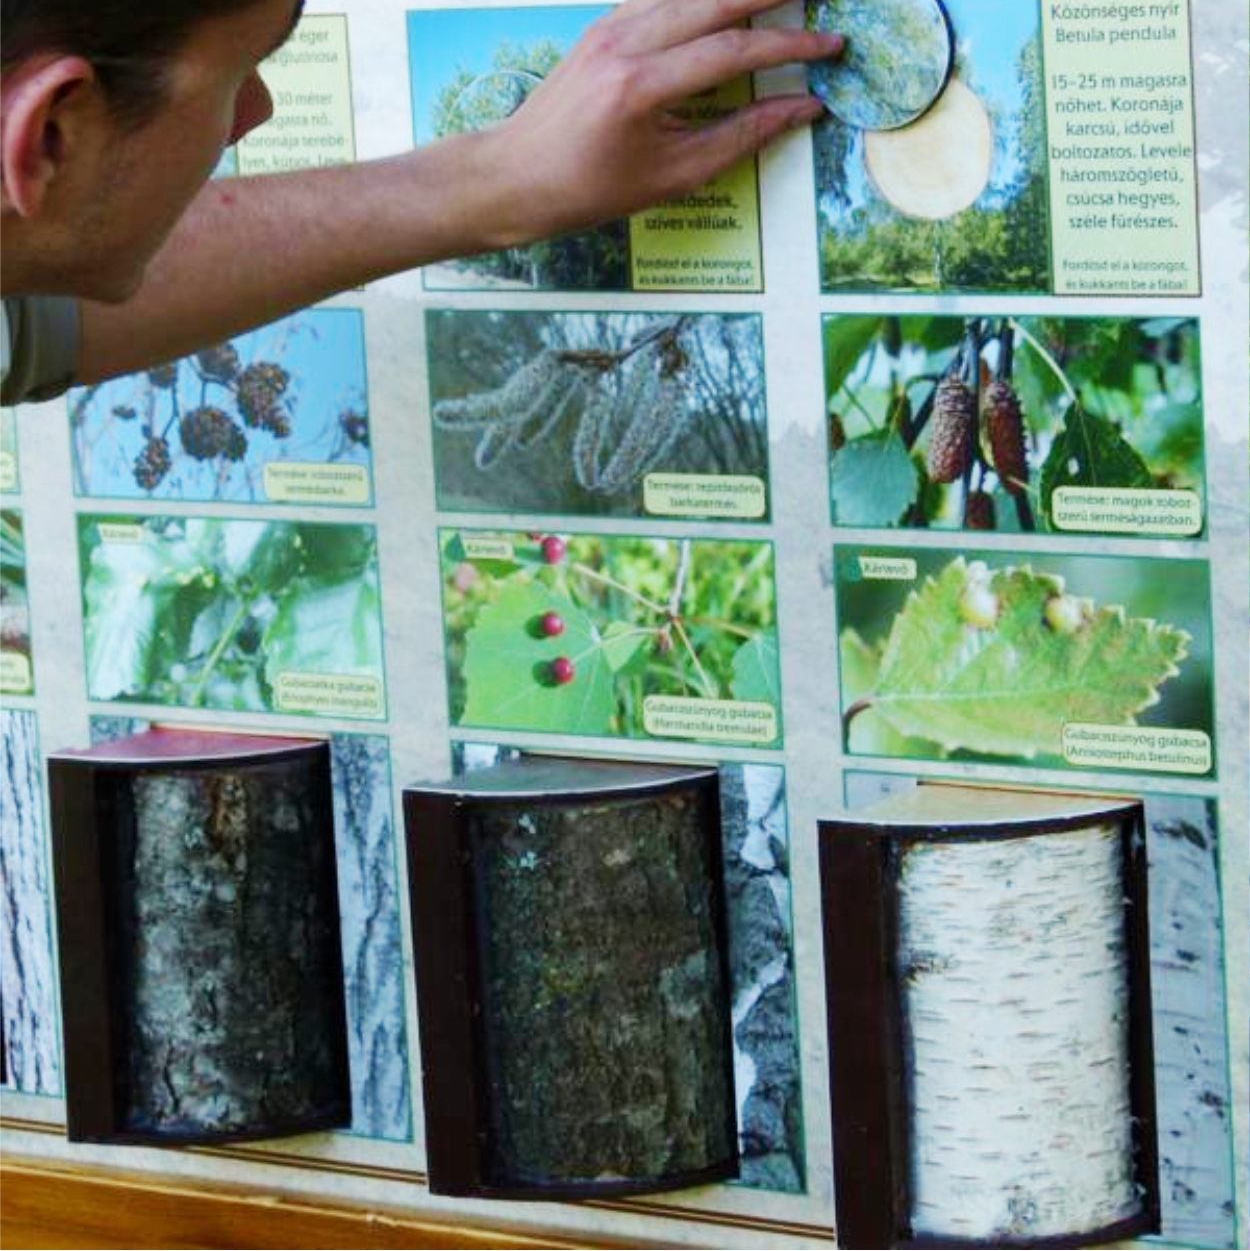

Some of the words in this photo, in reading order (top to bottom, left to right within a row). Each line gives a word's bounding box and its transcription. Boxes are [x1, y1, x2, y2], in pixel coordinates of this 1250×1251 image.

[1051, 1, 1146, 22] Közönséges
[1149, 0, 1180, 20] nyír
[1055, 26, 1106, 43] Betula
[1109, 25, 1177, 45] pendula
[1101, 78, 1115, 89] m
[1119, 74, 1187, 93] magasra
[1110, 96, 1183, 115] Koronája
[1051, 144, 1137, 160] boltozatos.
[1141, 143, 1192, 159] Levele
[1117, 191, 1180, 209] hegyes,
